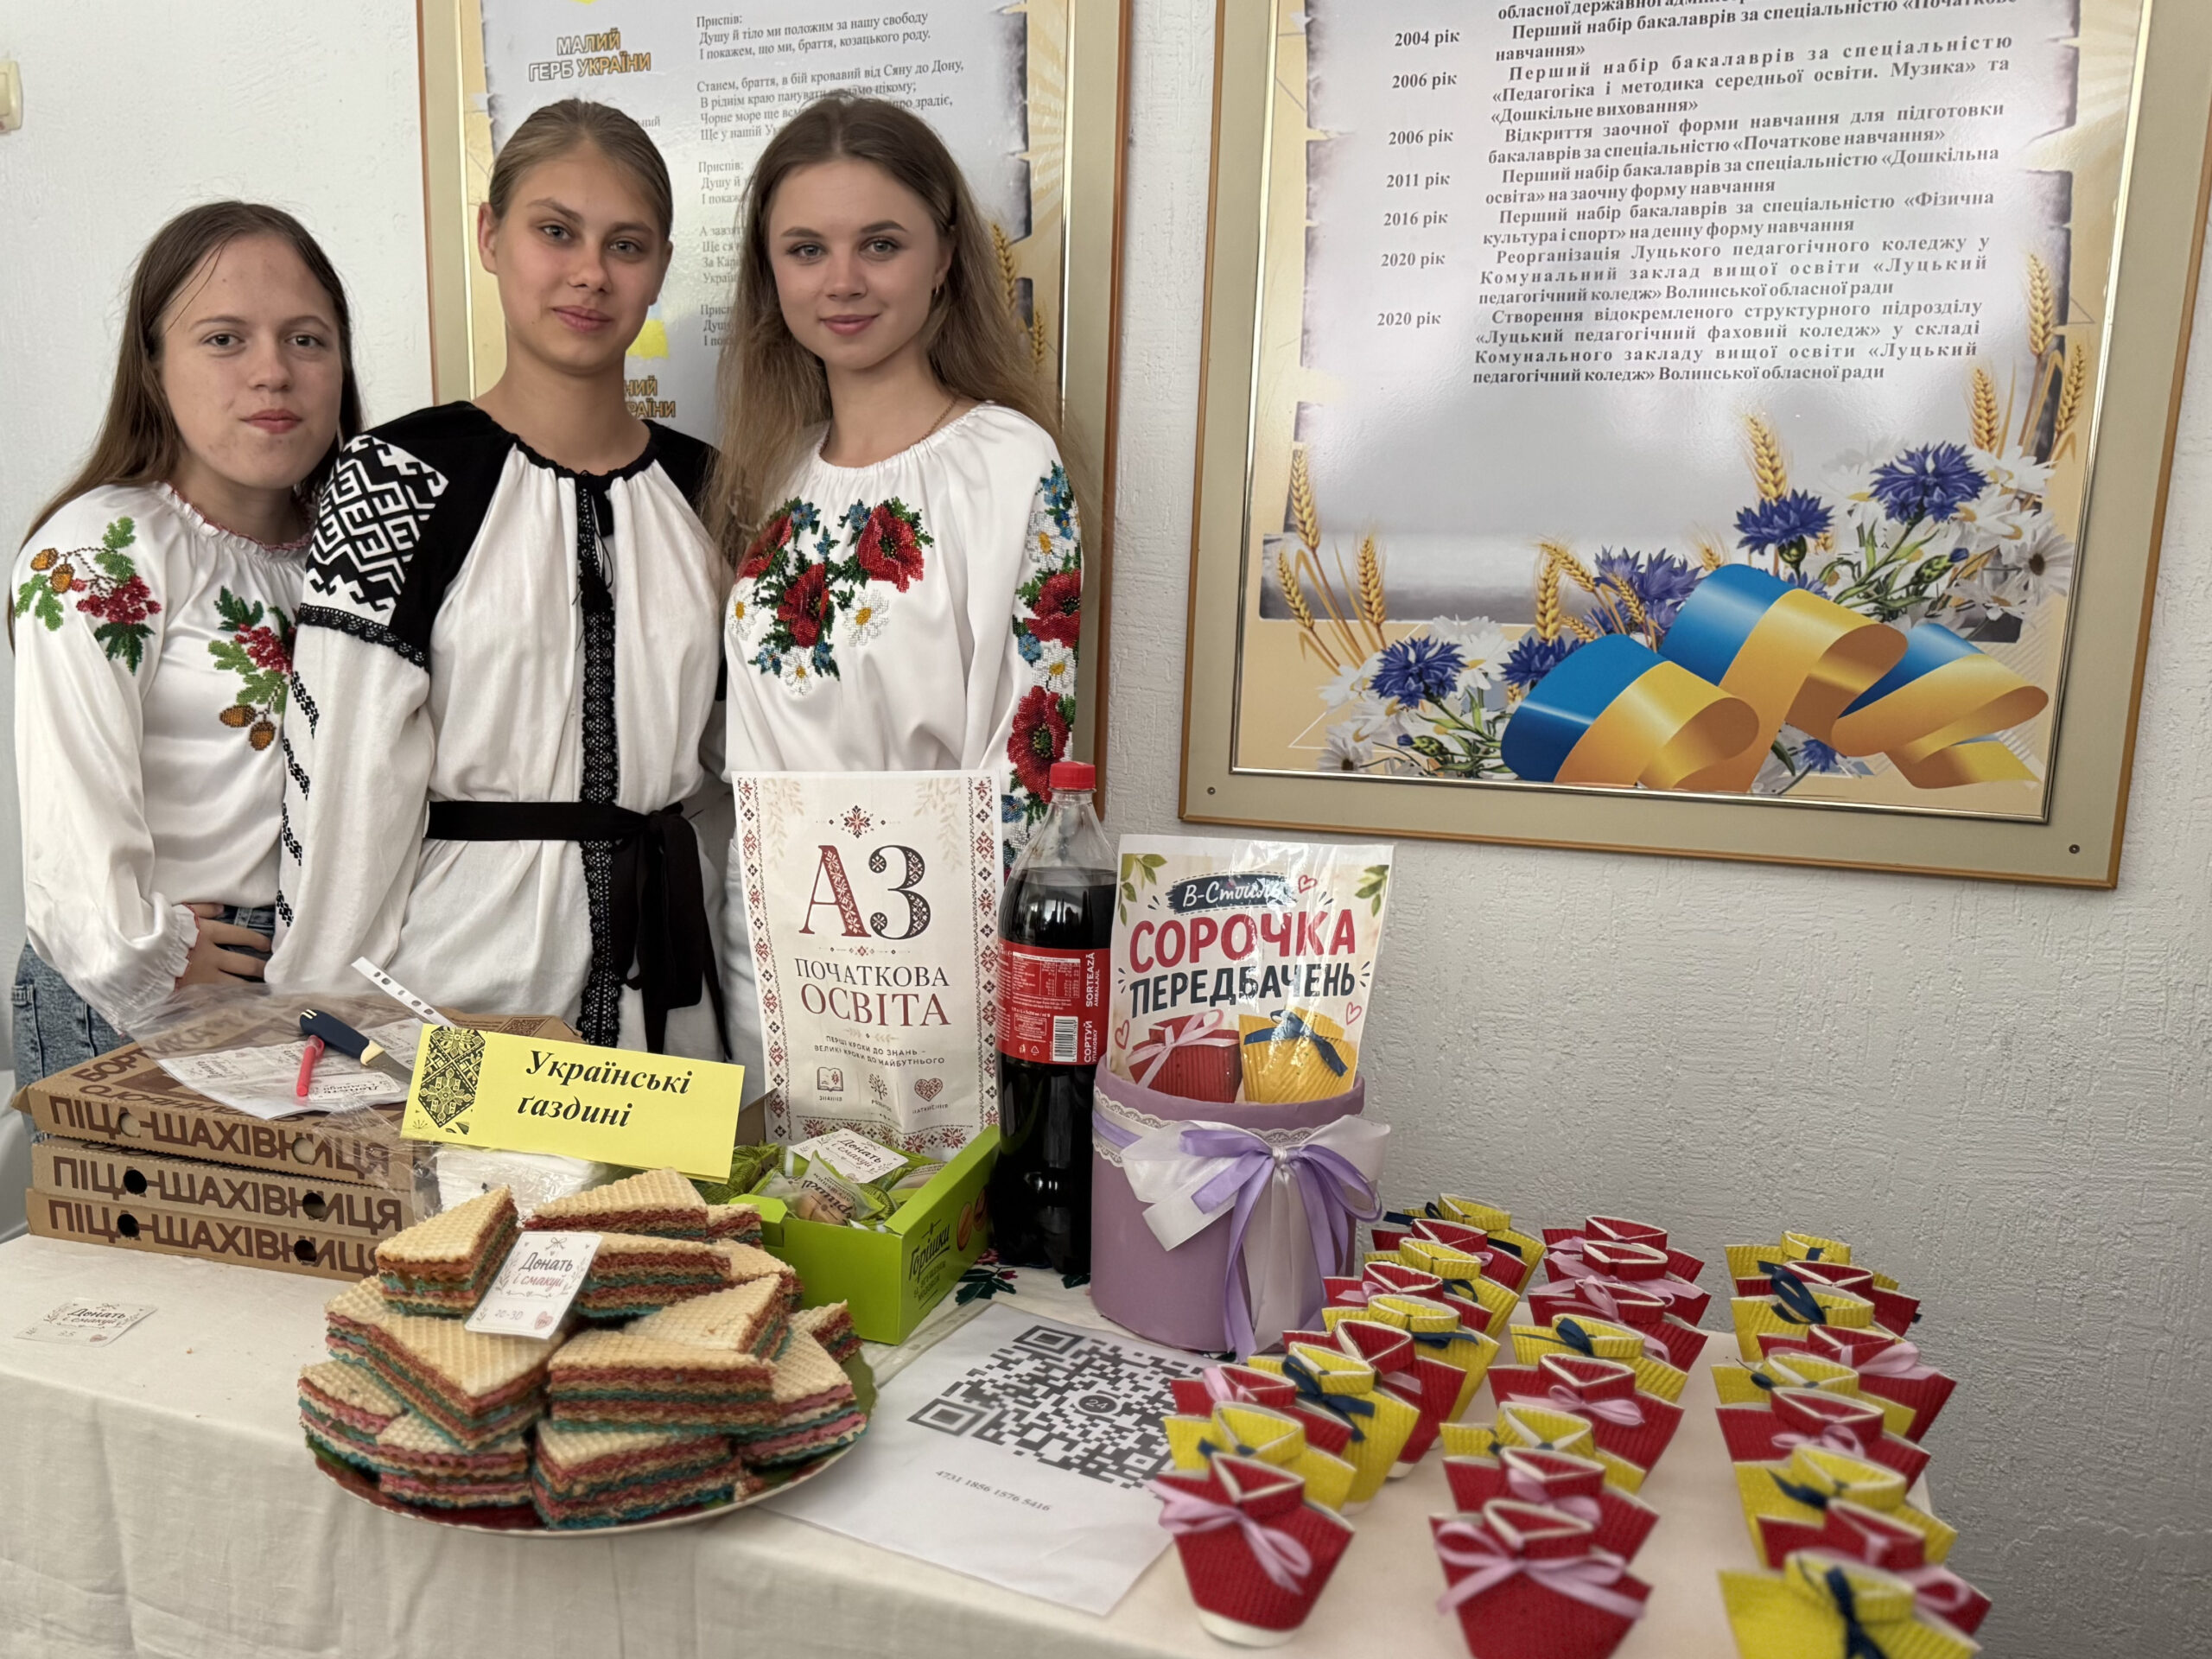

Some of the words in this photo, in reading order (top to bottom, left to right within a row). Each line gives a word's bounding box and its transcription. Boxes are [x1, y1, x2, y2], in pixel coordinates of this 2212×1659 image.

[696, 14, 742, 29] Приспів:
[699, 31, 729, 46] Душу
[733, 29, 740, 41] й
[742, 27, 764, 40] тіло
[766, 27, 781, 38] ми
[784, 22, 834, 36] положим
[836, 21, 848, 31] за
[850, 18, 880, 32] нашу
[883, 12, 928, 28] свободу
[1512, 21, 1581, 40] Перший
[1587, 17, 1631, 35] набір
[1637, 8, 1737, 30] бакалаврів
[1741, 10, 1758, 22] за
[1764, 0, 1898, 20] спеціальністю
[557, 28, 620, 55] МАЛИЙ
[1395, 32, 1429, 47] 2004
[1434, 29, 1460, 48] рік
[1496, 44, 1585, 61] навчання»
[529, 60, 573, 81] ГЕРБ
[578, 52, 651, 77] УКРАЇНИ
[1509, 61, 1590, 82] Перший
[1604, 56, 1658, 76] набір
[1672, 48, 1795, 72] бакалаврів
[1808, 48, 1829, 61] за
[1842, 35, 2012, 60] спеціальністю
[1391, 74, 1427, 88] 2006
[1433, 72, 1457, 90] рік
[1492, 84, 1594, 104] «Педагогіка
[1605, 79, 1611, 95] і
[1622, 78, 1703, 95] методика
[1715, 70, 1803, 91] середньої
[1814, 65, 1878, 84] освіти.
[1891, 60, 1976, 79] Музика»
[1988, 58, 2009, 73] та
[1491, 105, 1593, 124] «Дошкільне
[1596, 99, 1699, 118] виховання»
[1505, 127, 1592, 144] Відкриття
[1603, 120, 1669, 137] заочної
[1679, 118, 1738, 135] форми
[1751, 111, 1840, 129] навчання
[1850, 111, 1885, 125] для
[1897, 104, 2004, 124] підготовки
[1389, 131, 1424, 145] 2006
[1428, 130, 1453, 147] рік
[1386, 174, 1420, 188] 2011
[1426, 171, 1450, 189] рік
[1502, 167, 1570, 185] Перший
[1575, 163, 1619, 181] набір
[1624, 157, 1720, 178] бакалаврів
[1724, 159, 1742, 173] за
[1746, 152, 1878, 172] спеціальністю
[1882, 147, 1999, 167] «Дошкільна
[1383, 213, 1418, 226] 2016
[1423, 210, 1448, 227] рік
[1499, 207, 1567, 226] Перший
[1576, 205, 1621, 224] набір
[1630, 200, 1727, 219] бакалаврів
[1736, 201, 1753, 214] за
[1763, 195, 1895, 214] спеціальністю
[1904, 192, 1994, 209] «Фізична
[1381, 253, 1415, 267] 2020
[1421, 251, 1446, 268] рік
[1497, 246, 1620, 265] Реорганізація
[1630, 245, 1721, 262] Луцького
[1732, 238, 1870, 257] педагогічного
[1882, 235, 1967, 254] коледжу
[1979, 235, 1989, 251] у
[1479, 264, 1618, 286] Комунальний
[1630, 264, 1700, 282] заклад
[1713, 261, 1778, 278] вищої
[1790, 258, 1859, 275] освіти
[1873, 254, 1988, 276] «Луцький
[1377, 312, 1412, 327] 2020
[1416, 309, 1441, 327] рік
[1491, 308, 1584, 326] Створення
[1594, 304, 1732, 323] відокремленого
[1745, 302, 1871, 321] структурного
[1882, 299, 1982, 318] підрозділу
[1476, 327, 1563, 347] «Луцький
[1574, 325, 1695, 343] педагогічний
[1707, 322, 1787, 341] фаховий
[1799, 322, 1880, 340] коледж»
[1892, 324, 1904, 340] у
[1916, 320, 1980, 337] складі
[1129, 909, 1355, 973] СОРОЧКА
[795, 958, 950, 987] ПОЧАТКОВА
[801, 983, 951, 1027] ОСВІТА
[1129, 963, 1355, 1018] ПЕРЕДБАЧЕНЬ
[1084, 1020, 1093, 1063] СОРТУЙ
[525, 1049, 693, 1094] Українські
[54, 1156, 403, 1236] ПІЦ-ШАХІВНИЦЯ
[518, 1252, 573, 1272] Донать
[521, 1274, 566, 1293] смакуй
[1090, 1399, 1108, 1410] 24
